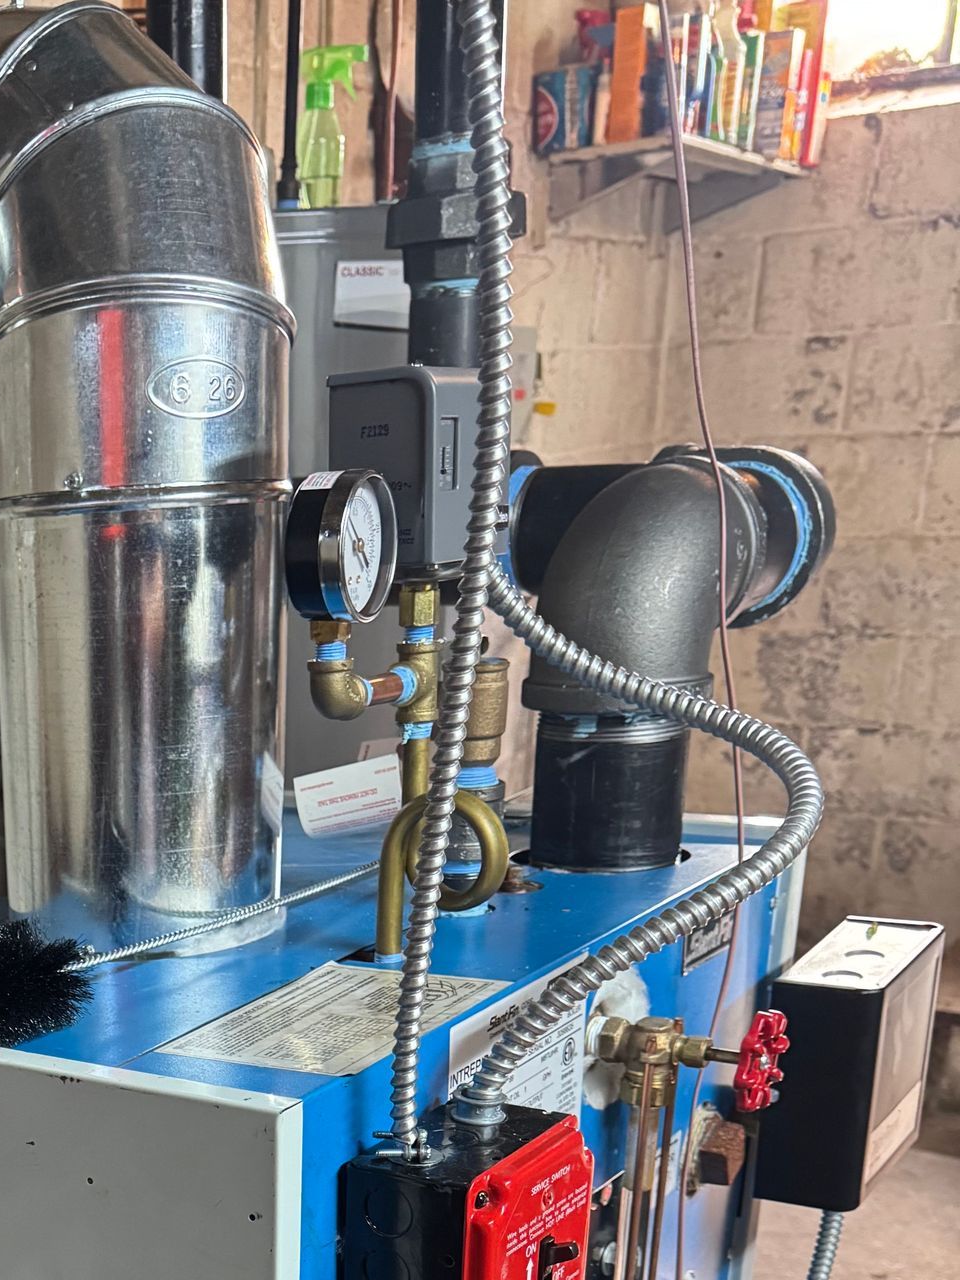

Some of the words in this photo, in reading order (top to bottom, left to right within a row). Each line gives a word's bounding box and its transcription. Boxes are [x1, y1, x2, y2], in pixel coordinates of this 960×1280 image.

[341, 265, 385, 278] CLASSIC
[170, 372, 191, 404] 6
[208, 375, 236, 402] 26
[450, 1055, 488, 1089] INTREP
[531, 1178, 550, 1196] SERVICE
[551, 1164, 571, 1183] SWITCH
[526, 1241, 537, 1258] ON
